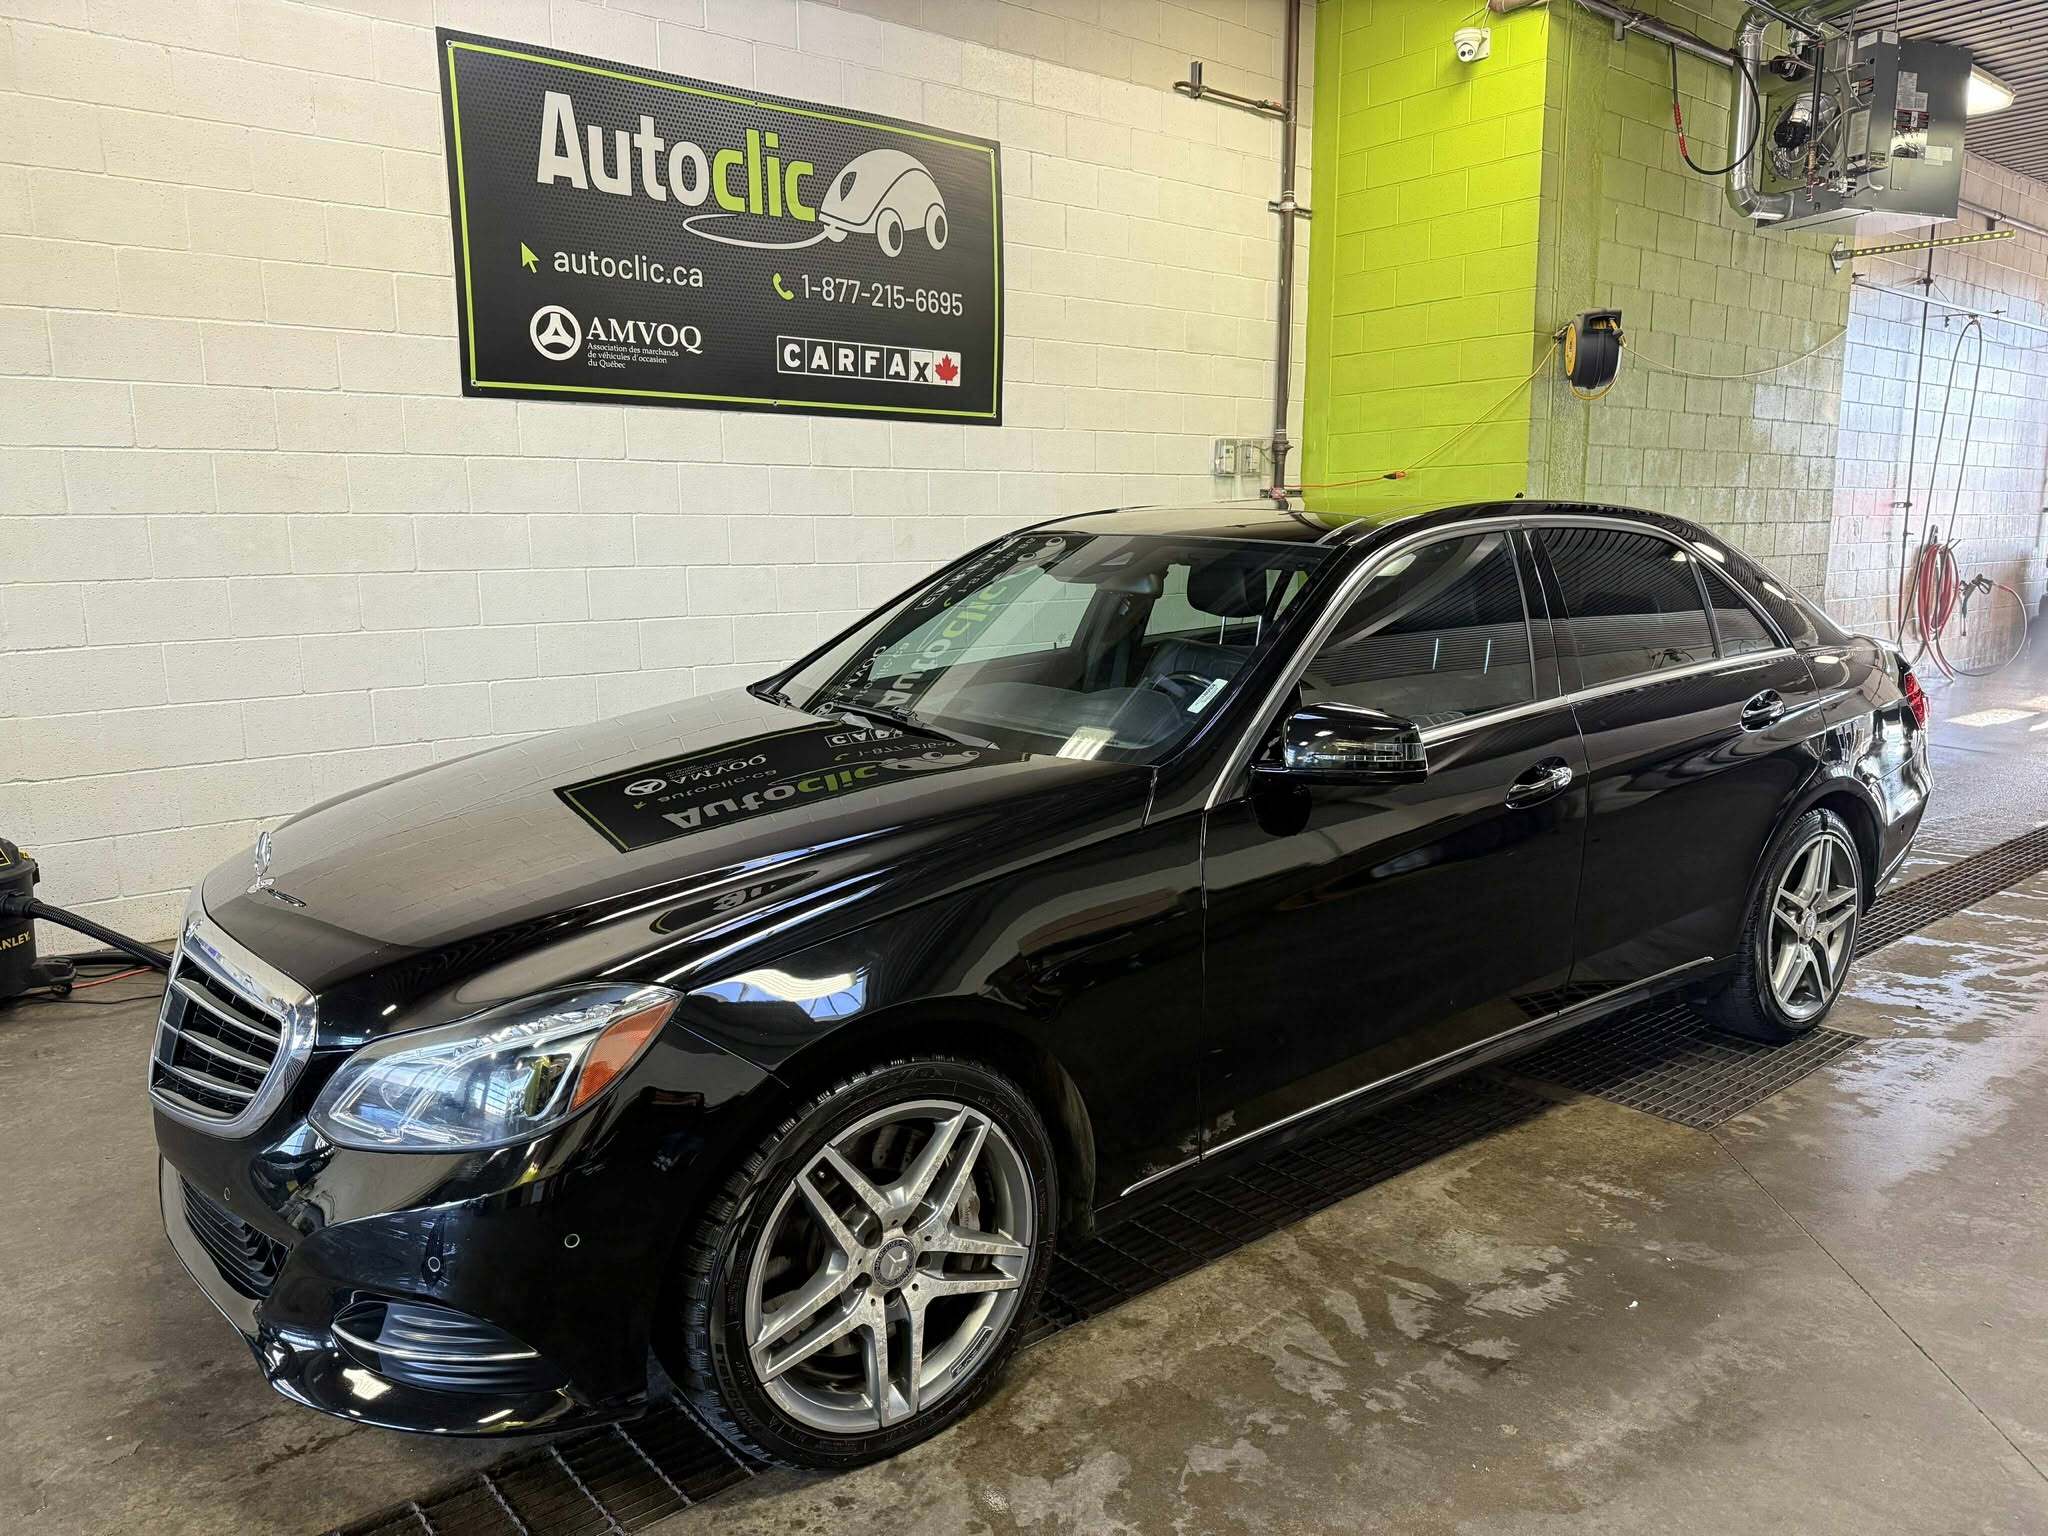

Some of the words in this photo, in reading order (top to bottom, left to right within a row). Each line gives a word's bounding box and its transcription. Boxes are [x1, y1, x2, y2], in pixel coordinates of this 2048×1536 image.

[536, 90, 817, 222] Autoclic
[552, 246, 704, 288] autoclic.ca
[801, 273, 964, 317] 1-877-215-6695
[586, 317, 703, 354] AMVOQ
[587, 342, 627, 355] Association
[628, 346, 640, 354] des
[641, 348, 680, 358] marchands
[587, 350, 597, 359] de
[599, 360, 626, 369] Québec
[784, 343, 929, 382] CARFAX
